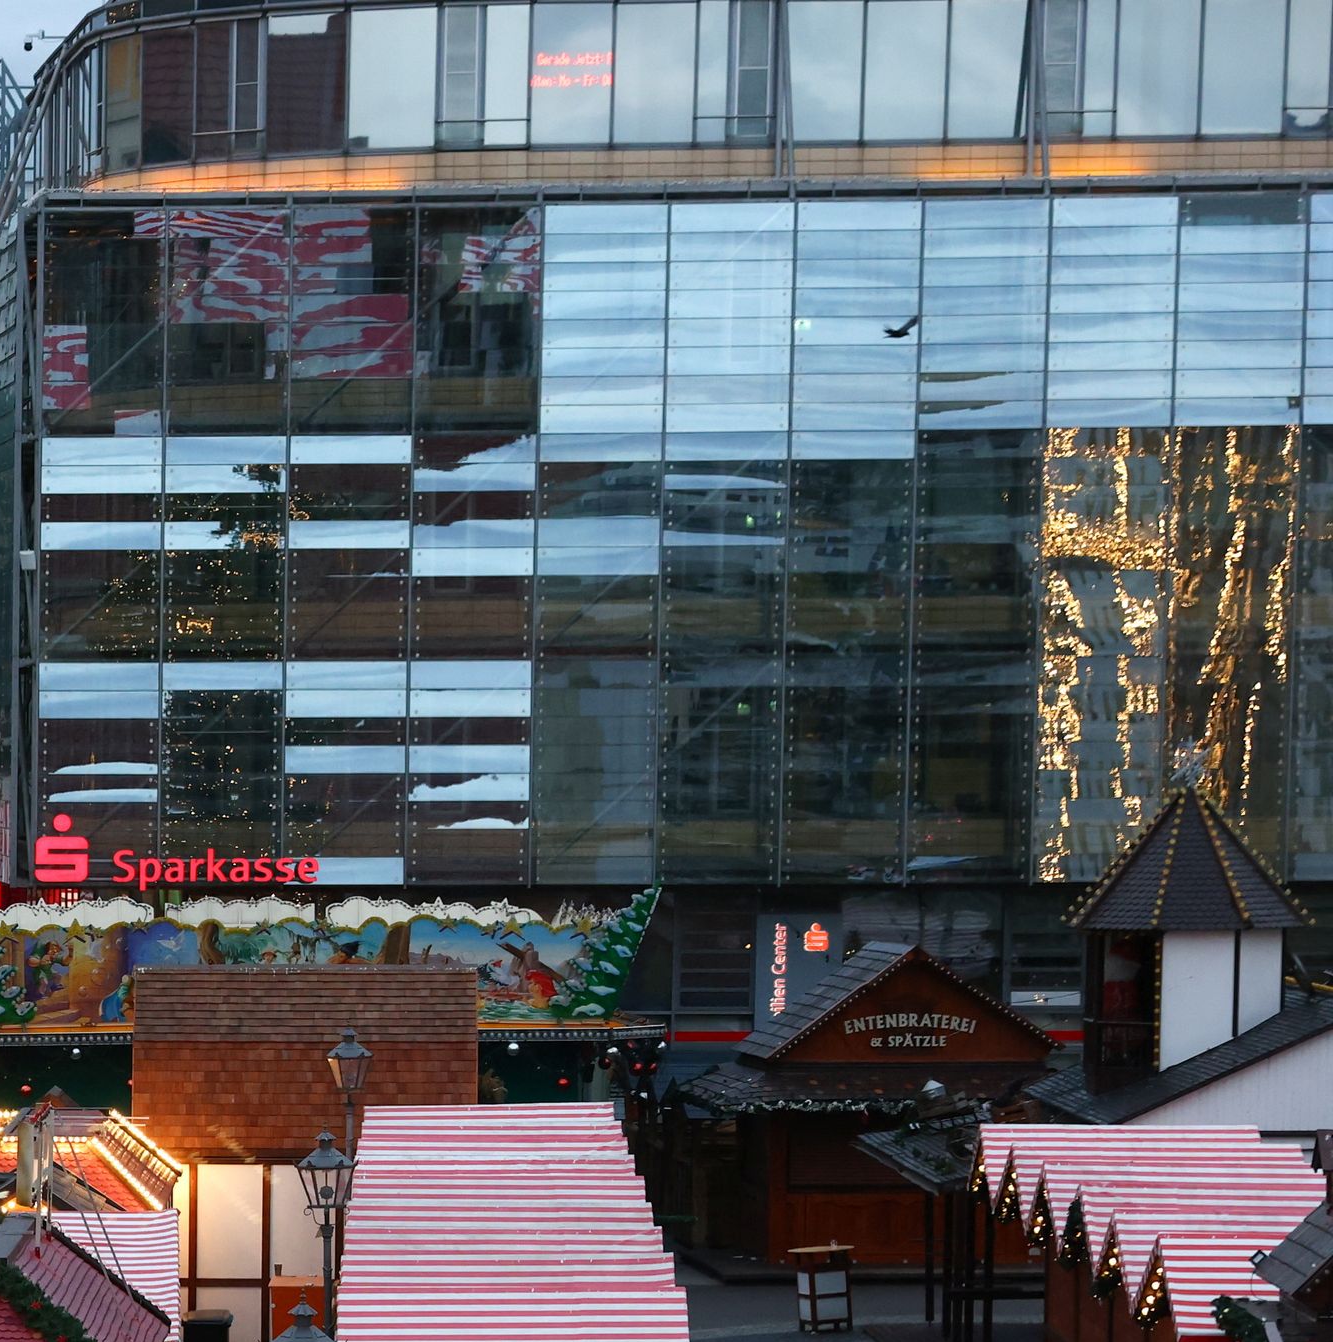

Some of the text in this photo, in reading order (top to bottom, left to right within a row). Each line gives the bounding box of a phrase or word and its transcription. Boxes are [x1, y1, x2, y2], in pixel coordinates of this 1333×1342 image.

[112, 848, 320, 891] Sparkasse
[771, 923, 787, 975] Center
[844, 1013, 977, 1035] ENTENBRATEREI
[870, 1032, 947, 1047] & SPÄTZLE
